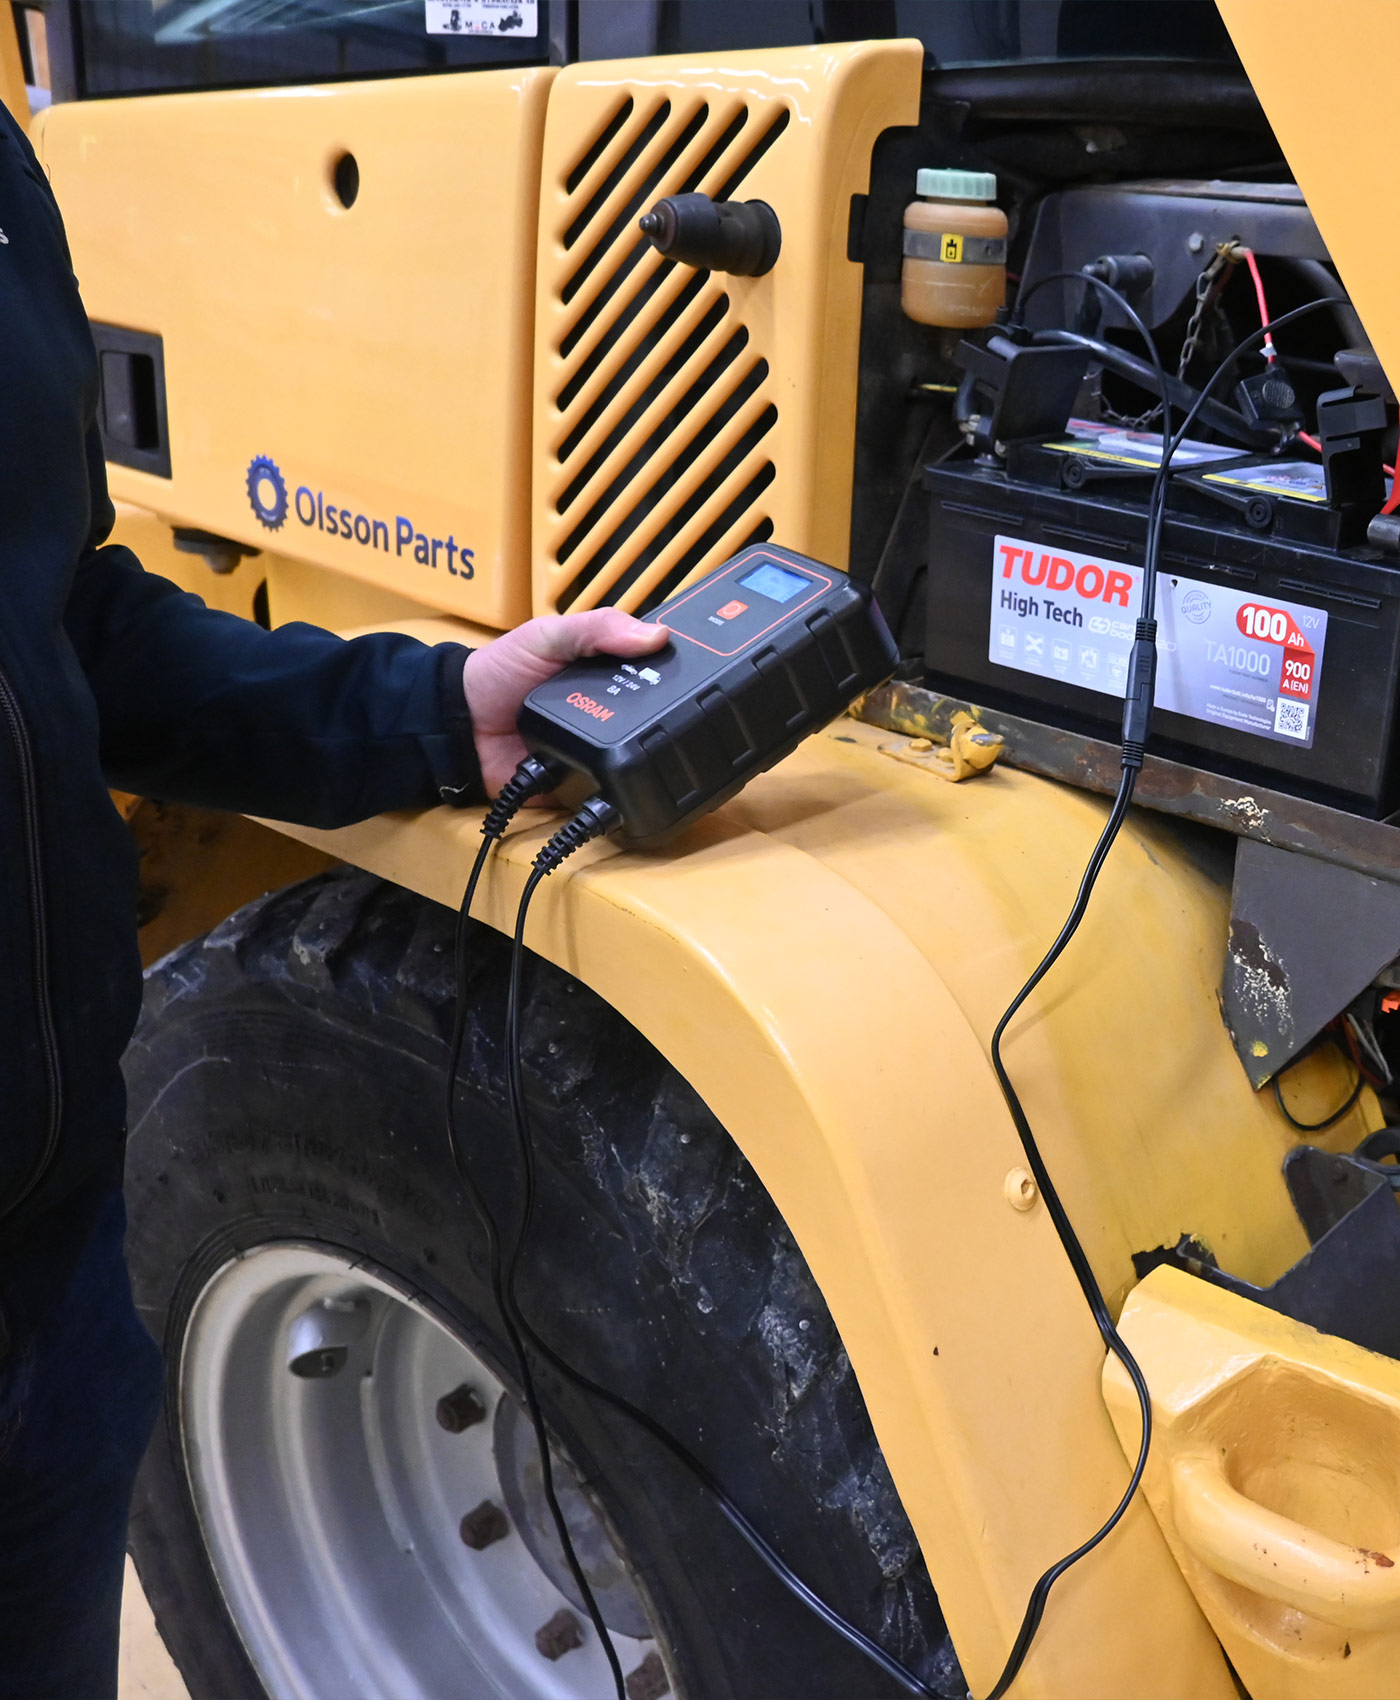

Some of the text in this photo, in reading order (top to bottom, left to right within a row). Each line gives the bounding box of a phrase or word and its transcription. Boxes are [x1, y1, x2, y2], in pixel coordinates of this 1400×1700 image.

[1000, 544, 1133, 608] TUDOR
[1000, 589, 1083, 628] High Tech
[1181, 601, 1212, 614] QUALITY
[1302, 615, 1320, 629] 12V
[1242, 606, 1305, 647] 100 Ah
[1204, 639, 1271, 676] TA1000
[1285, 660, 1311, 680] 900
[1282, 679, 1309, 694] A (EN)
[566, 692, 615, 722] OSRAM
